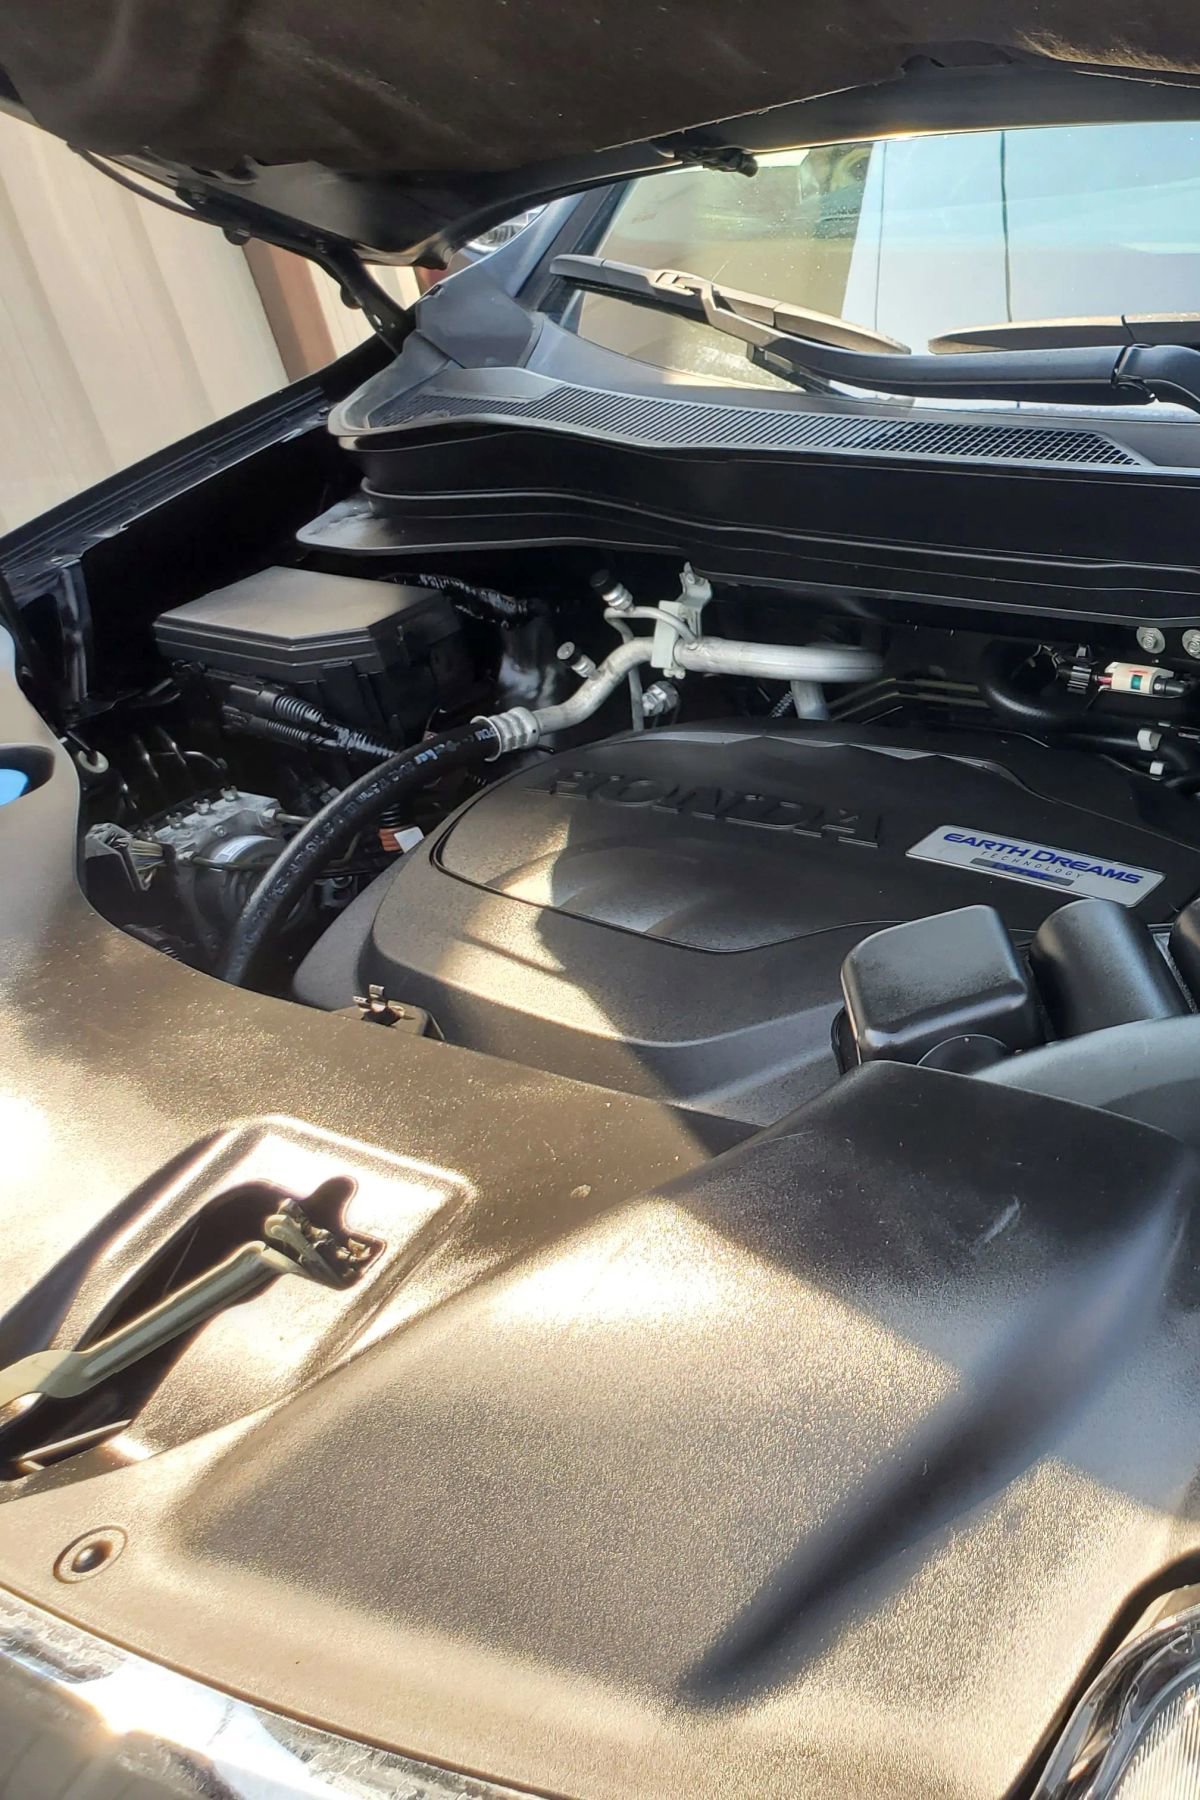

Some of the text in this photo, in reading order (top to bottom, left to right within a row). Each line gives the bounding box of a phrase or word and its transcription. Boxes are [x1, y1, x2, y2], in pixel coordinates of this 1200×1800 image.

[521, 766, 881, 848] HONDA
[943, 832, 1031, 857] EARTH
[1030, 849, 1144, 884] DREAMS
[981, 851, 1084, 879] TECHNOLOGY
